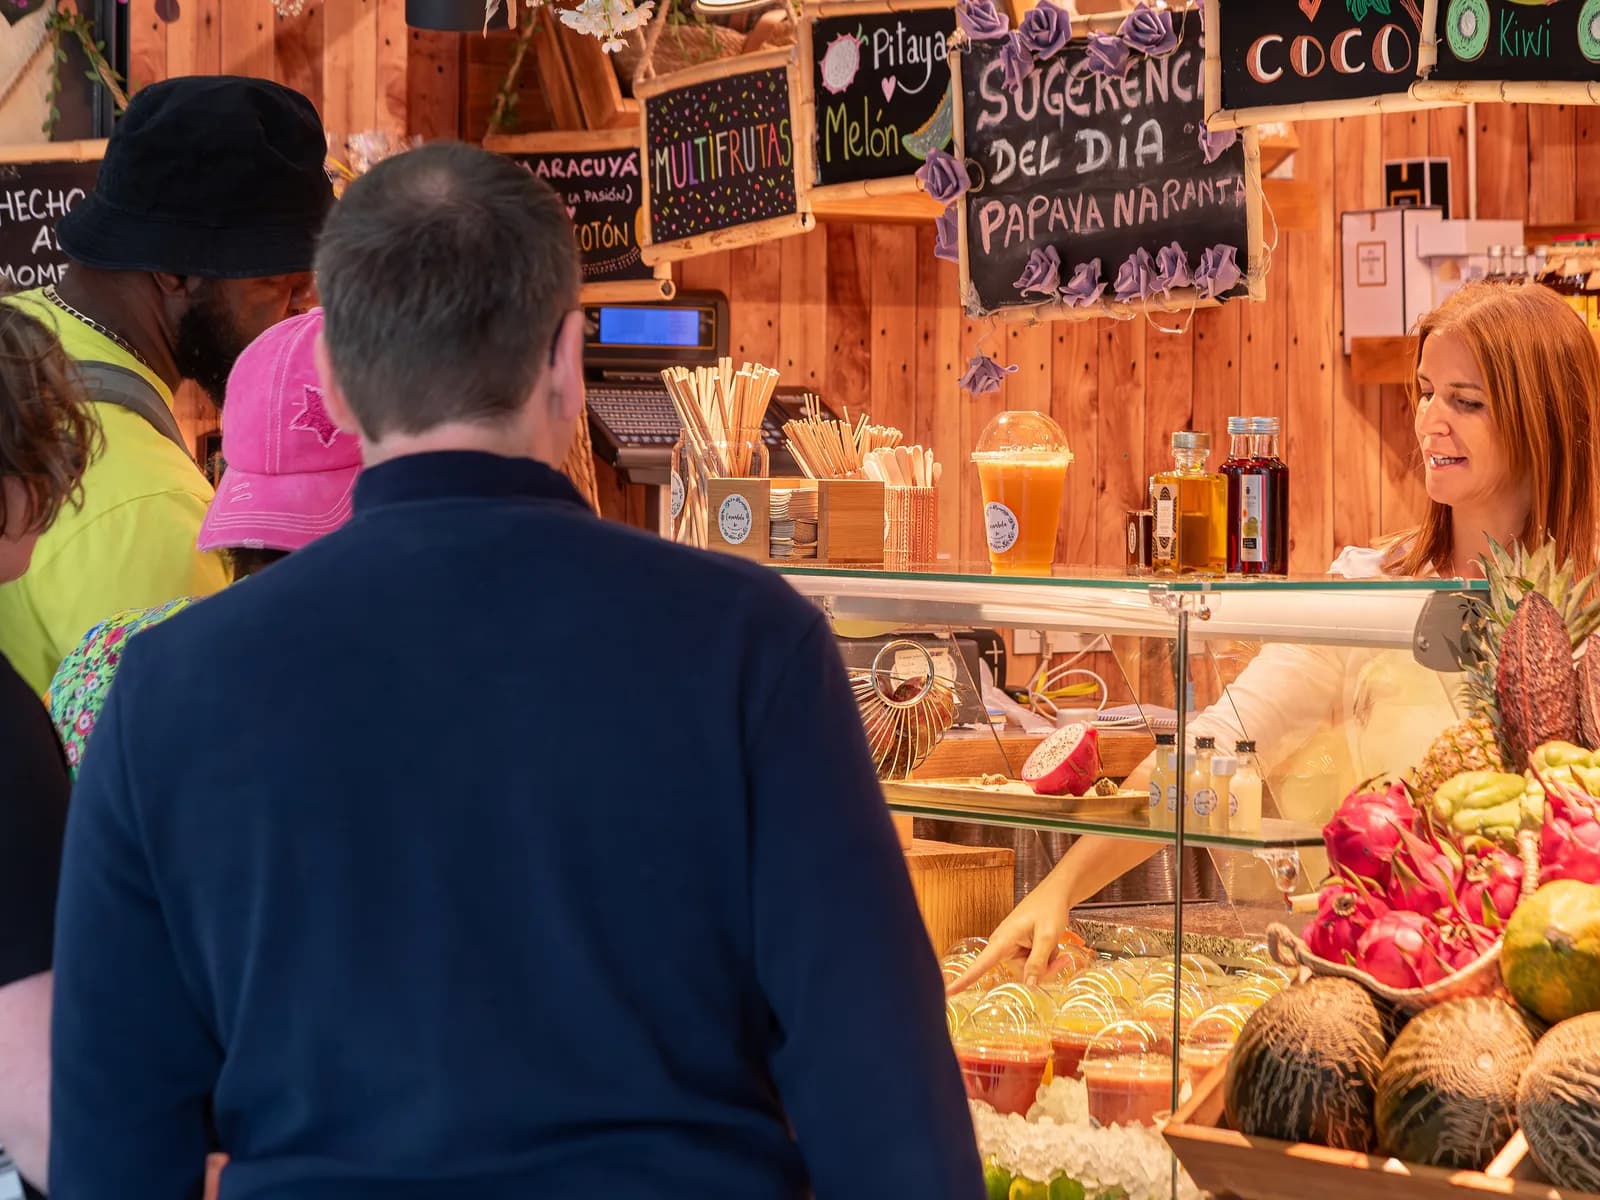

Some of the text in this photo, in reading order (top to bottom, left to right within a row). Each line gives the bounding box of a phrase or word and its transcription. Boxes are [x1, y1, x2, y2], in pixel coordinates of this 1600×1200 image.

[873, 21, 947, 94] Pitaya
[1246, 23, 1413, 84] COCO
[1498, 8, 1552, 59] Kiwi
[655, 118, 792, 195] MULTIFRUTAS
[825, 96, 899, 163] Melón
[988, 134, 1061, 185] DEL
[979, 175, 1246, 253] PAPAYA NARANJA
